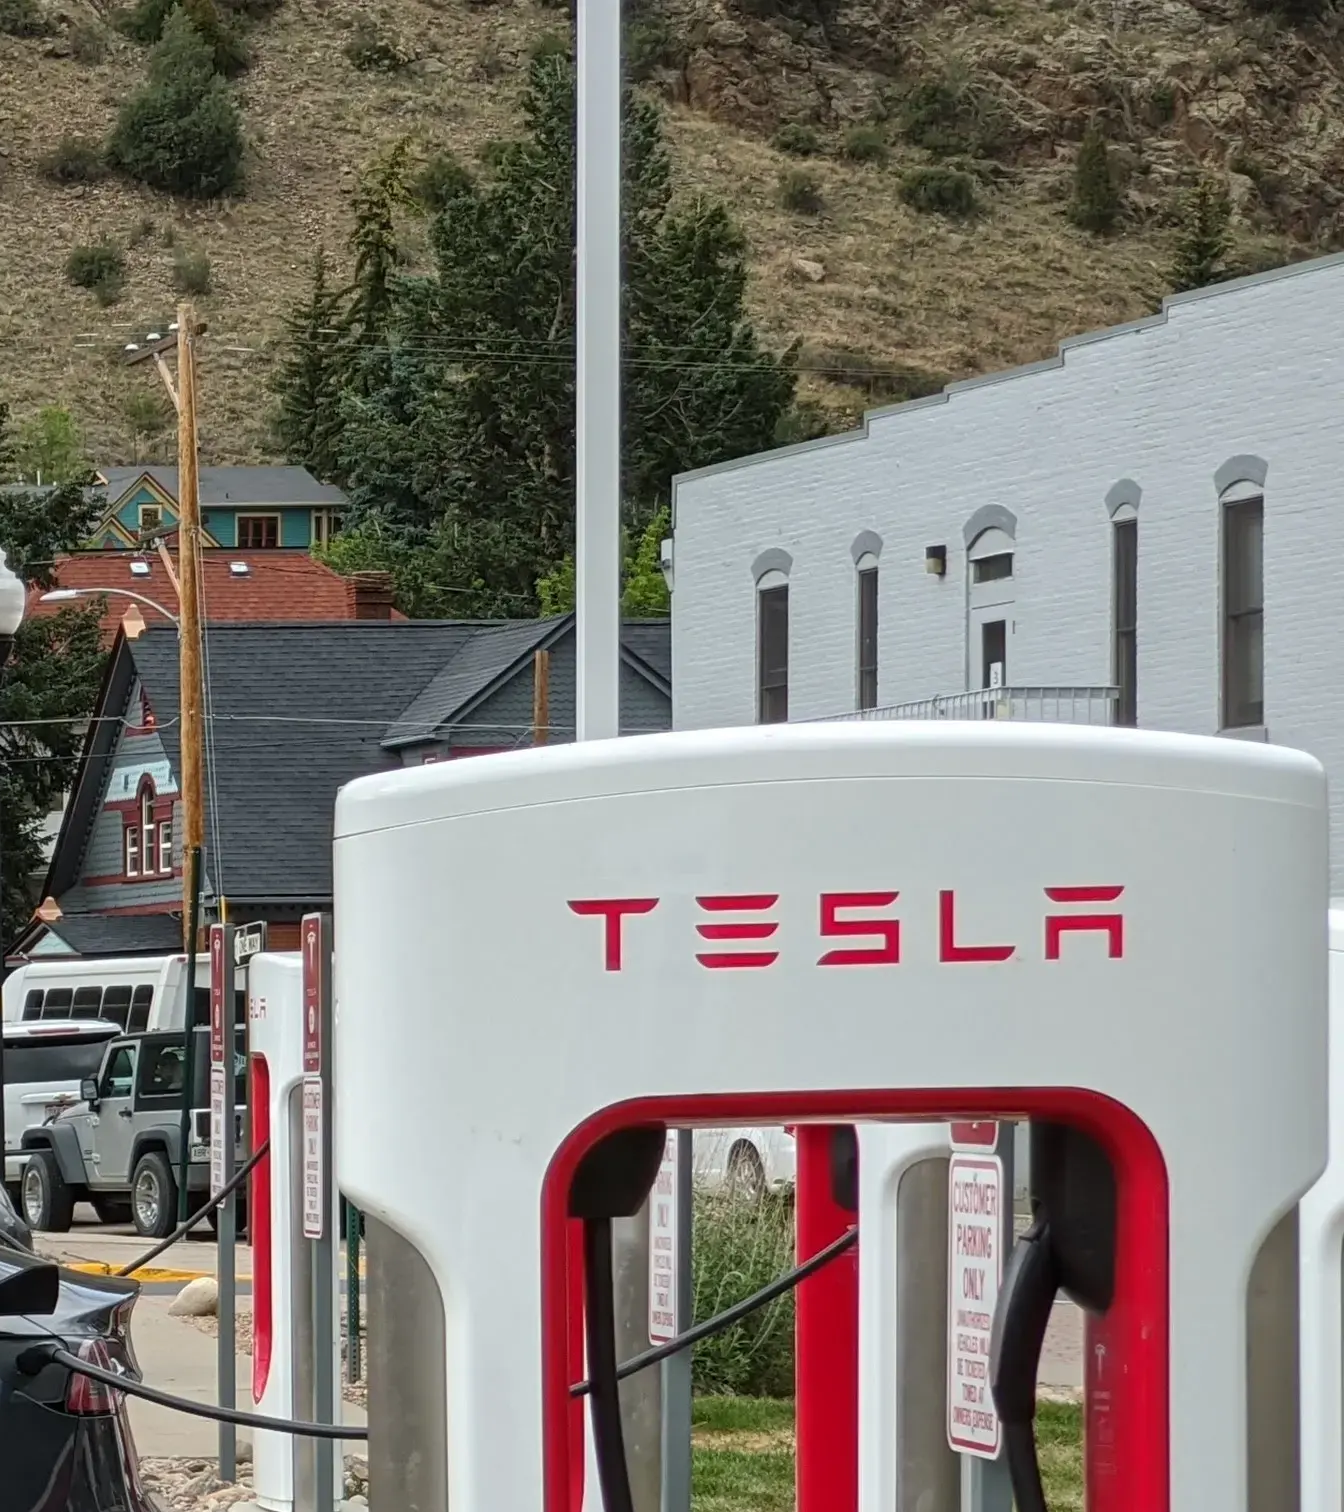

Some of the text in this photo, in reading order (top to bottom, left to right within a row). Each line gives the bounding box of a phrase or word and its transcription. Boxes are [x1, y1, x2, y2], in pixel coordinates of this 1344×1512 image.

[566, 885, 1125, 971] TESLA
[953, 1181, 997, 1216] CUSTOMER
[956, 1223, 992, 1259] PARKING
[962, 1266, 986, 1302] ONLY
[972, 1409, 994, 1431] EXPENSE
